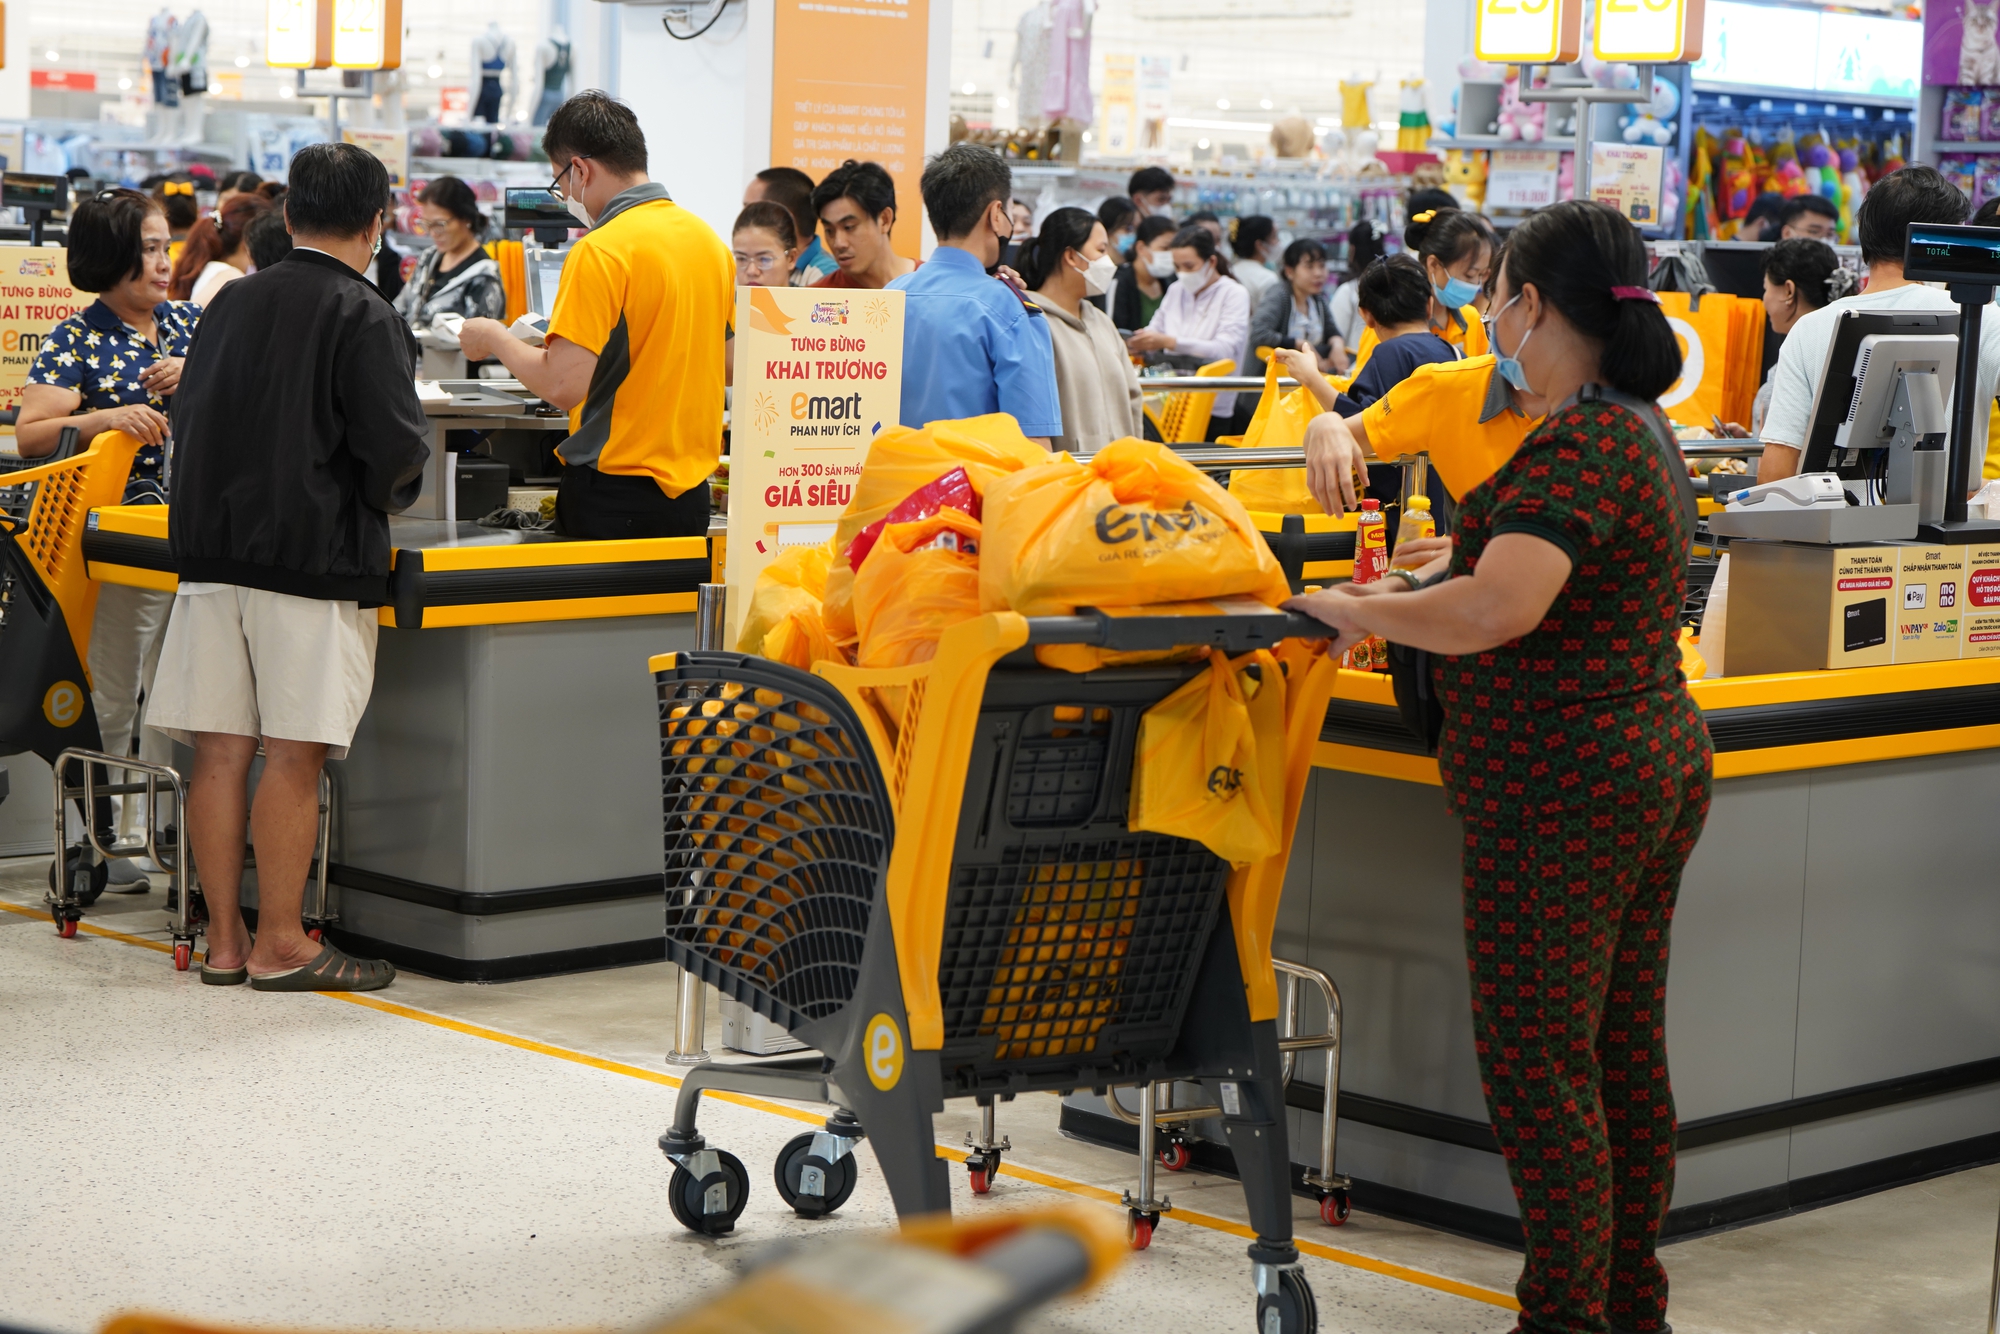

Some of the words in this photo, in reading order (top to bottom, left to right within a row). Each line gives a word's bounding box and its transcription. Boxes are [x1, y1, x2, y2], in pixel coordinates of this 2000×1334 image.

[1926, 248, 1950, 256] TOTAL
[1, 285, 34, 298] TƯNG
[38, 284, 73, 298] BỪNG
[790, 336, 826, 352] TƯNG
[830, 334, 866, 352] BỪNG
[2, 356, 28, 365] PHAN
[766, 361, 810, 380] KHAI
[816, 358, 888, 380] TRƯƠNG
[790, 392, 862, 420] emart
[790, 426, 818, 436] PHAN
[820, 426, 840, 436] HUY
[842, 423, 860, 436] ÍCH
[779, 466, 798, 477] HƠN
[801, 464, 823, 476] 300
[825, 464, 842, 476] SẢN
[764, 480, 803, 507] GIÁ
[806, 479, 851, 506] SIÊU
[1869, 556, 1883, 564] TOÁN
[1926, 552, 1941, 560] emart
[1839, 566, 1854, 575] CÙNG
[1854, 565, 1863, 574] THẺ
[1882, 565, 1893, 573] VIÊN
[1903, 564, 1916, 572] CHẤP
[1917, 564, 1931, 572] NHẬN
[1912, 592, 1924, 603] Pay
[1847, 609, 1860, 618] emart
[1933, 620, 1958, 633] ZaloPay
[51, 688, 75, 720] e
[872, 1024, 896, 1079] e
